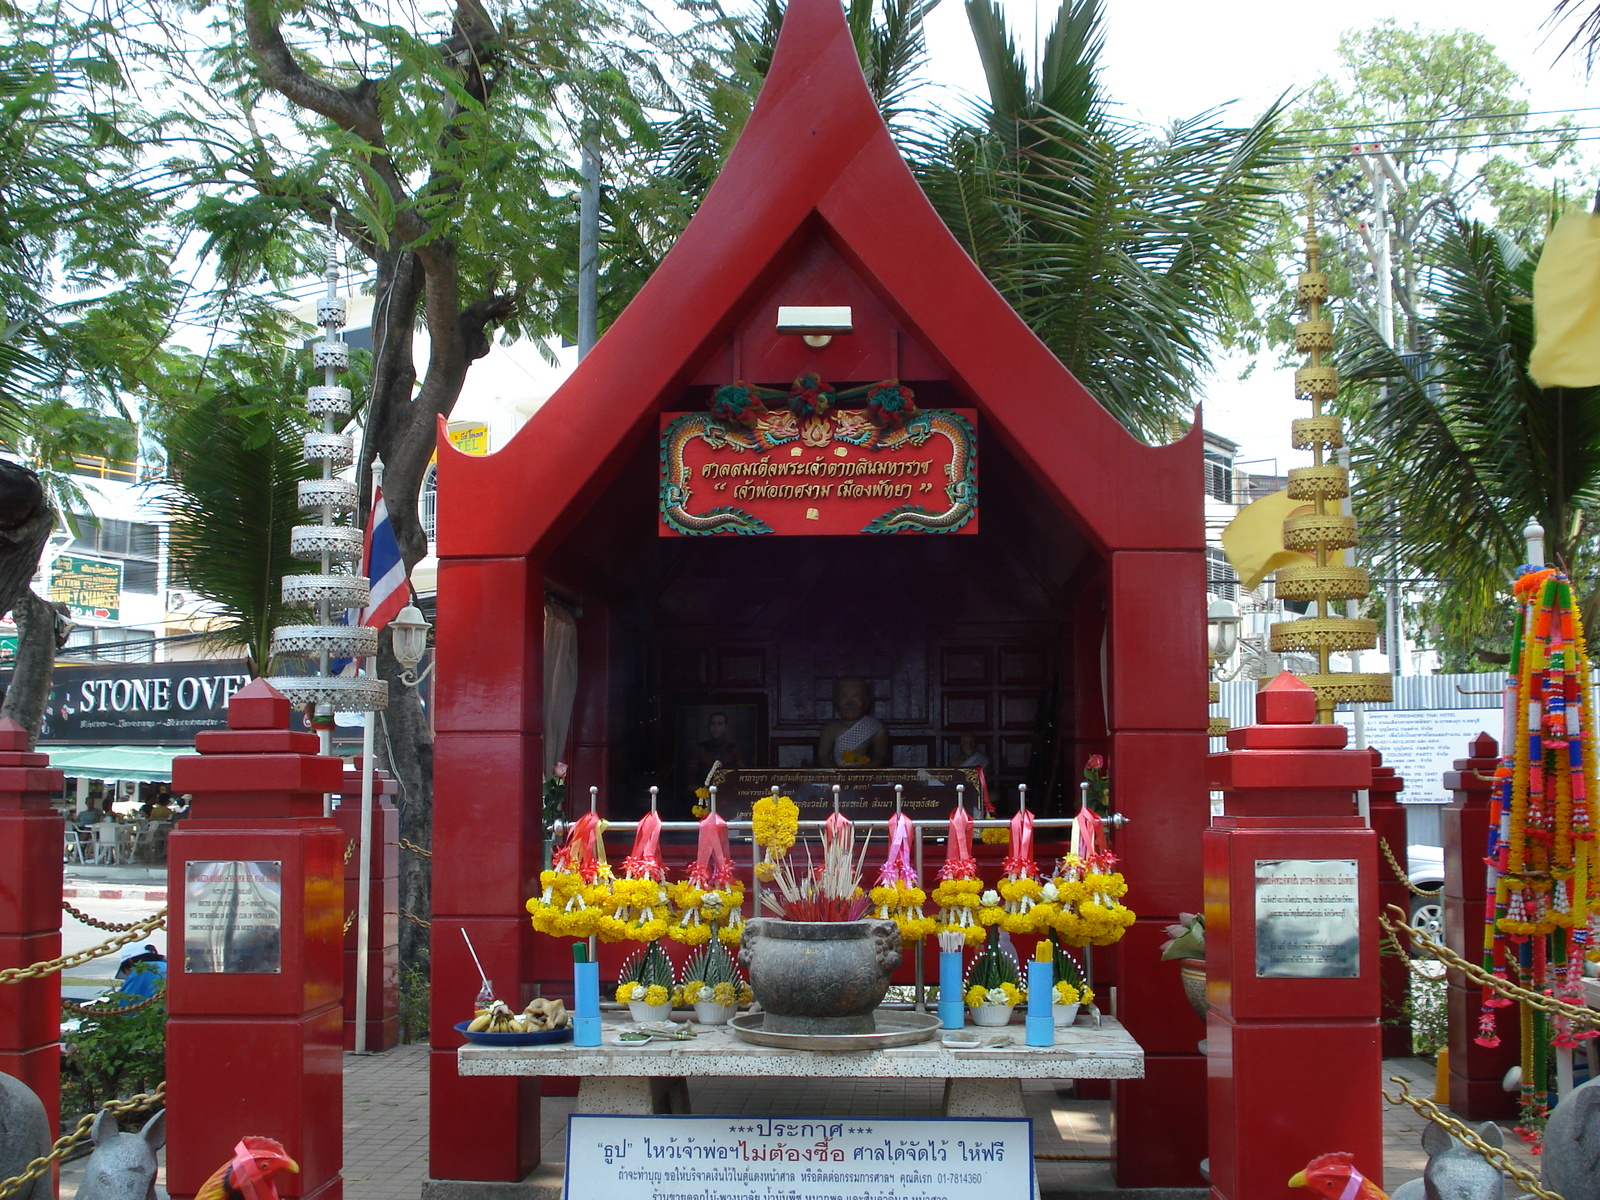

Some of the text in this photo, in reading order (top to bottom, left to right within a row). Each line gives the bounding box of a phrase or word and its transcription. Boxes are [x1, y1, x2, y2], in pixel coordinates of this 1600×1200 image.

[701, 456, 932, 478] ศาลสมเด็จพระเจ้าตากสินมหาราช
[733, 480, 834, 499] เจ้าพ่อเกศงาม
[836, 479, 913, 499] เมืองพัทยา
[79, 677, 172, 712] STONE
[757, 1119, 843, 1138] ประกาศ
[853, 1138, 949, 1162] ศาลได้จัดไว้
[958, 1140, 1005, 1162] ให้ฟรี
[618, 1166, 662, 1184] ถ้าจะทำบุญ
[937, 1173, 982, 1185] 01-7814360
